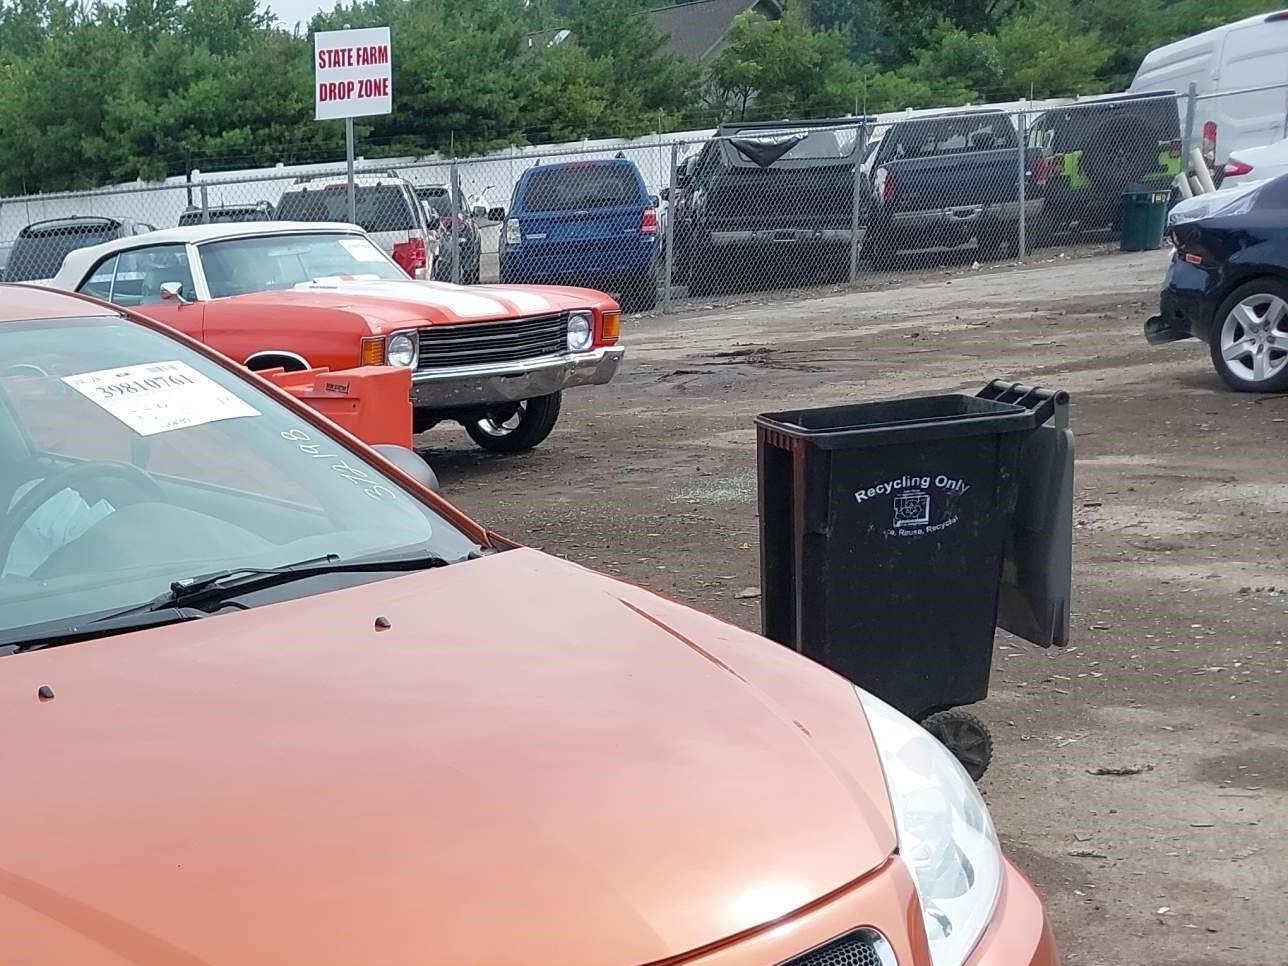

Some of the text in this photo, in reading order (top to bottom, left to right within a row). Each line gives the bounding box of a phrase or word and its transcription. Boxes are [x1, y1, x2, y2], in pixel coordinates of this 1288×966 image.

[318, 45, 389, 69] STATE FARM
[319, 77, 389, 102] DROP ZONE
[95, 374, 195, 399] 39810761
[854, 474, 971, 503] Recycling Only
